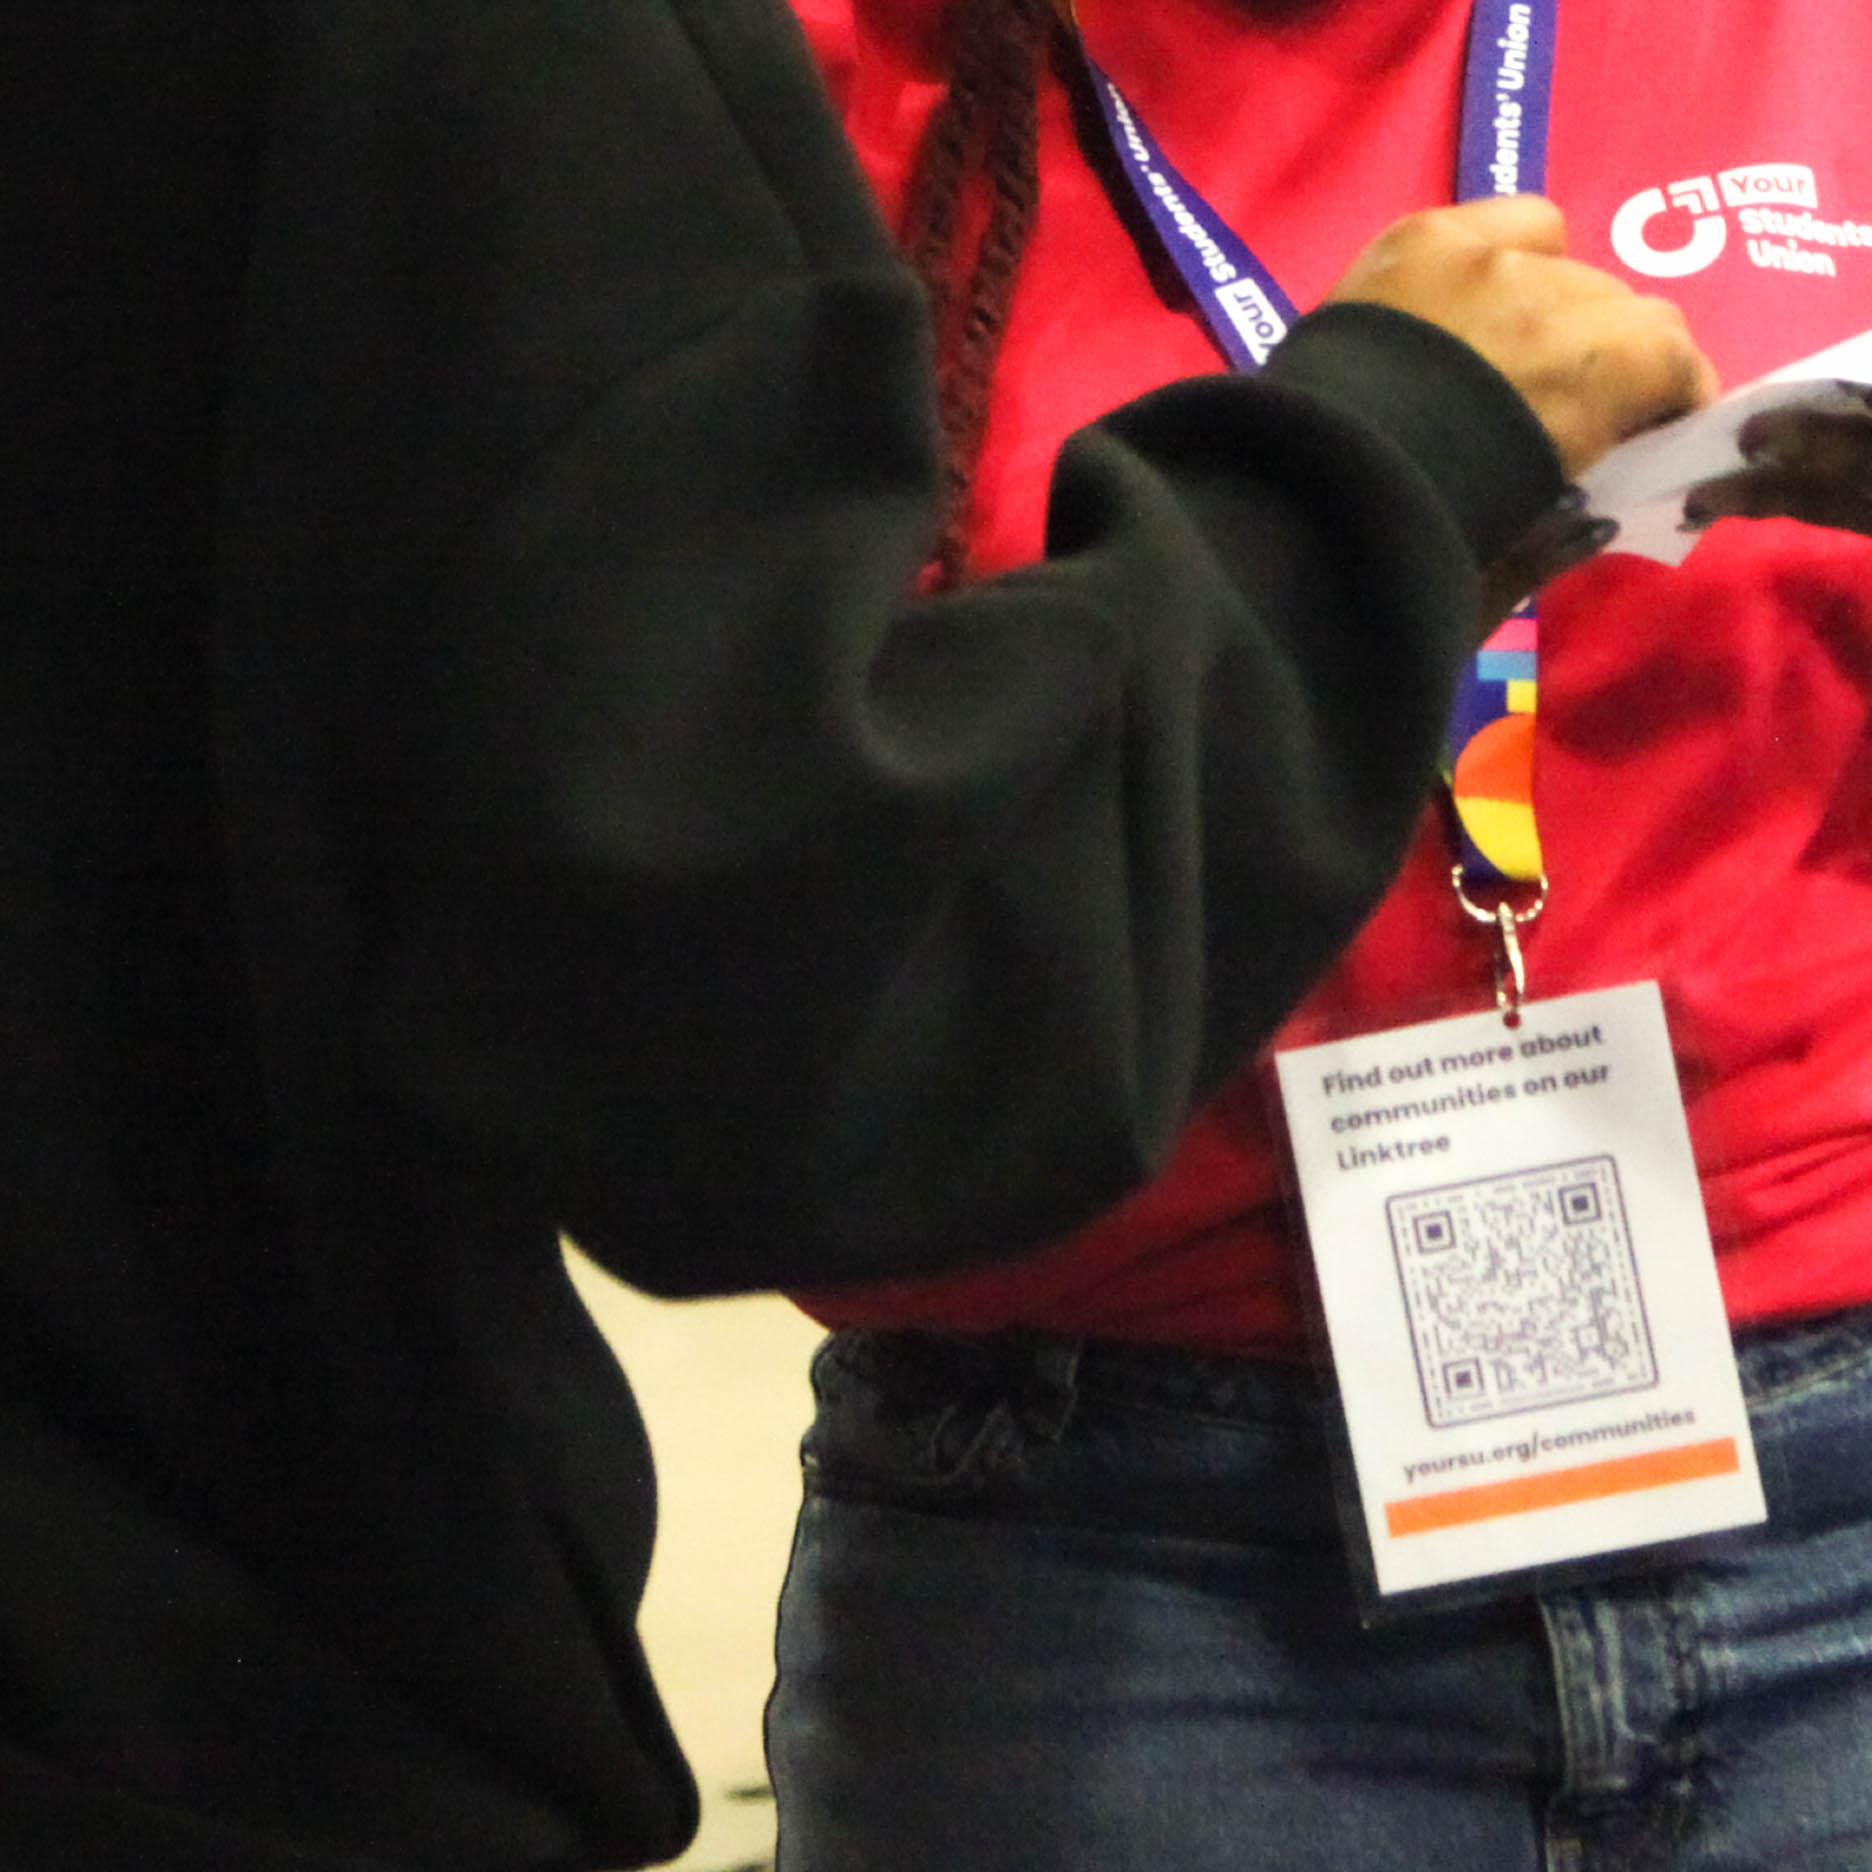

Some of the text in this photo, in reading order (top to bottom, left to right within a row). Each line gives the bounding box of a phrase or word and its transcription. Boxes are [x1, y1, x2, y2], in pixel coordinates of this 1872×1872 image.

[1496, 3, 1532, 91] Union
[1730, 174, 1806, 195] Your
[1140, 164, 1238, 284] Students'
[1746, 237, 1836, 277] Union
[1322, 1025, 1602, 1096] Find out more about
[1330, 1064, 1609, 1133] communities on our
[1337, 1135, 1451, 1171] Linktree
[1403, 1408, 1697, 1484] yoursu.org/communities
